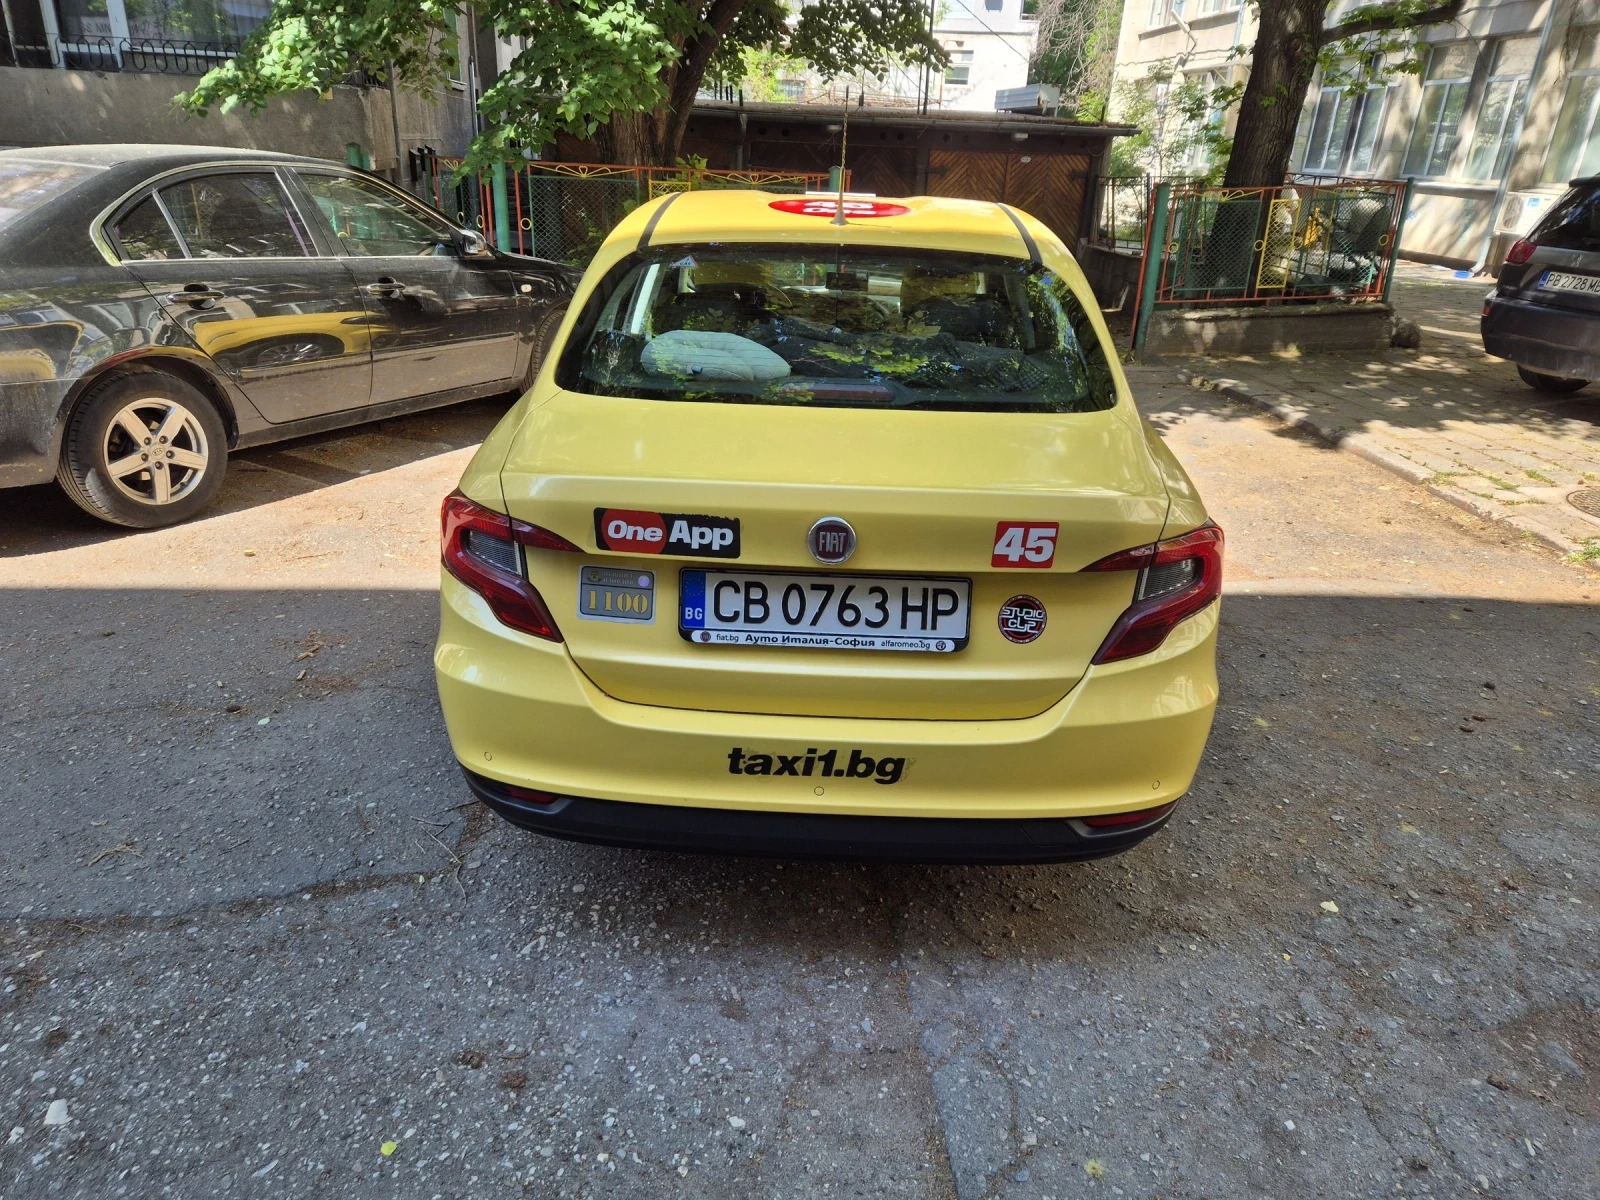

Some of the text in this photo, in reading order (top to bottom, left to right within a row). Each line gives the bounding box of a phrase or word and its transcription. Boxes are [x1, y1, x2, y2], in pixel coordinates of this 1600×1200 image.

[1546, 273, 1562, 287] PB
[1561, 276, 1588, 291] 2728
[607, 519, 734, 551] One App
[818, 531, 847, 553] FIAT
[993, 527, 1057, 562] 45
[588, 590, 648, 614] 1100
[713, 580, 959, 631] CB 0763 HP
[684, 607, 703, 620] BG
[716, 633, 739, 643] fiat.bg
[745, 634, 876, 648] Ауто Италия-София
[881, 639, 931, 650] alfaromeo.bg
[727, 747, 906, 785] taxi1.bg
